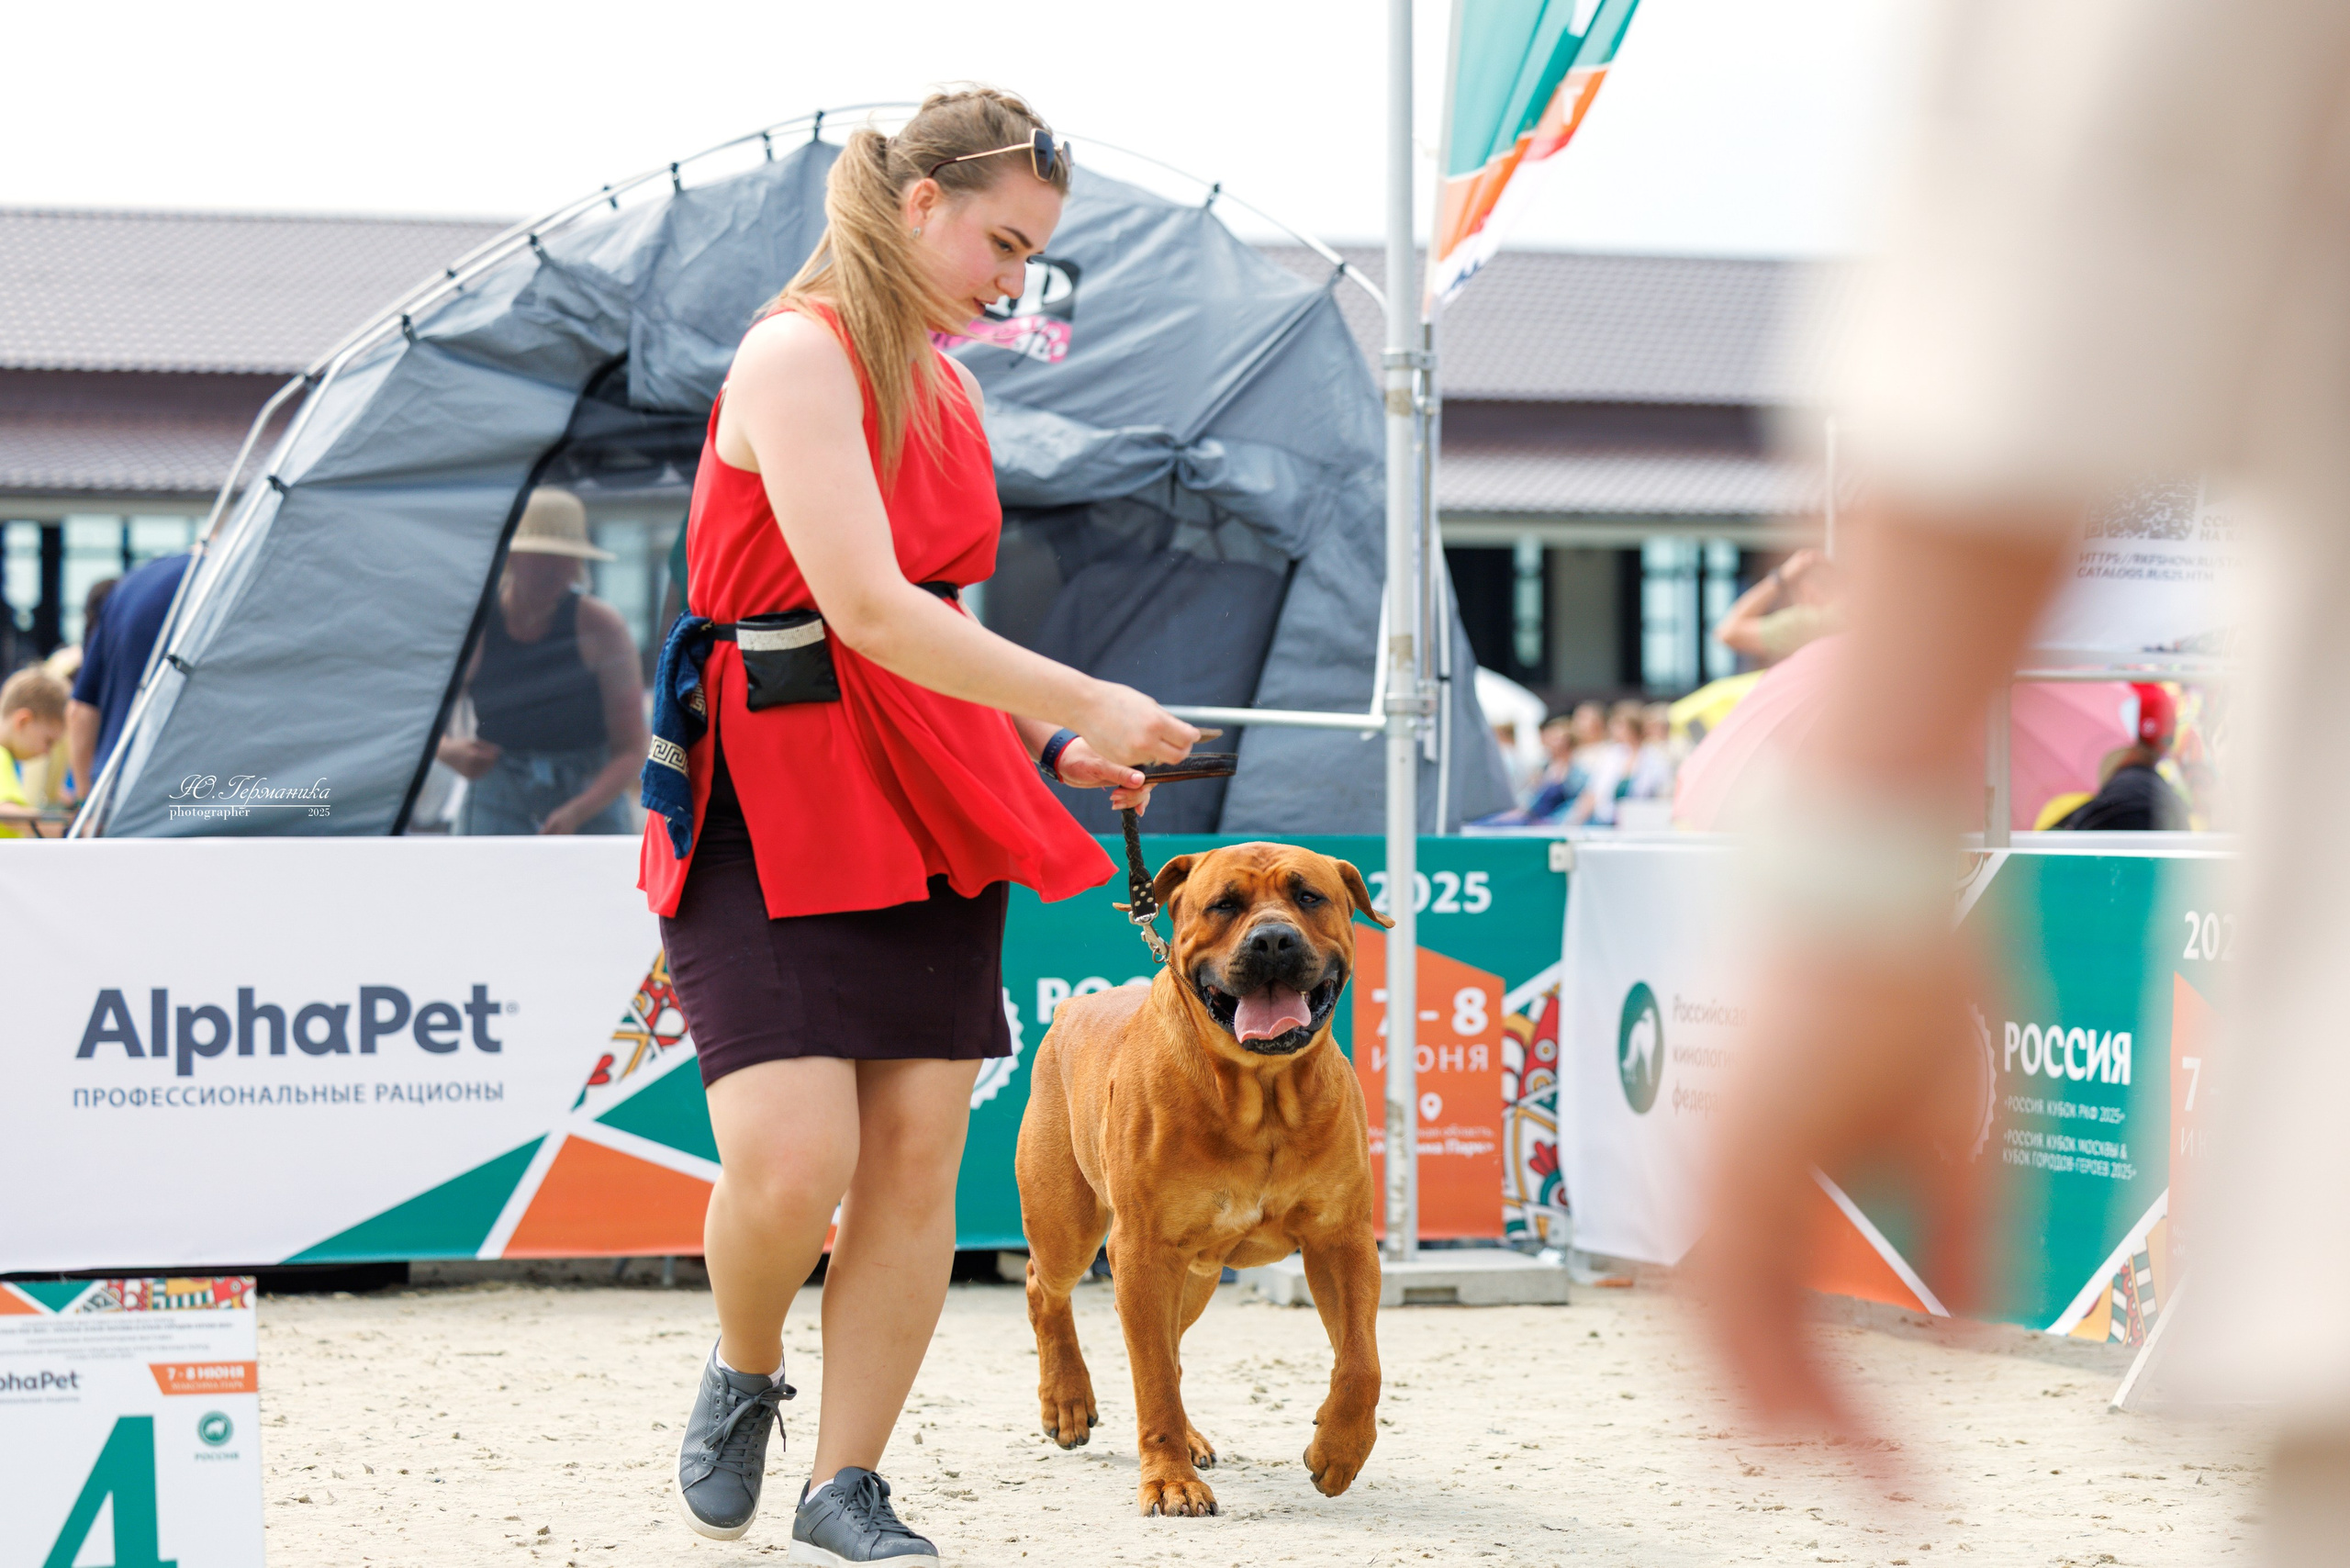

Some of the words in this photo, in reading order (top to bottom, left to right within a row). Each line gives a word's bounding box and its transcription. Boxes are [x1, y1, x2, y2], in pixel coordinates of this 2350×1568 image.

[2182, 910, 2235, 962] 202
[75, 982, 503, 1077] AlphaPet
[1451, 987, 1490, 1036] 8
[1673, 992, 1747, 1026] Российская
[2004, 1021, 2132, 1085] РОССИЯ
[73, 1083, 366, 1108] ПРОФЕССИОНАЛЬНЫЕ
[375, 1081, 504, 1107] РАЦИОНЫ
[2046, 1100, 2076, 1118] КУБОК
[2045, 1134, 2076, 1152] КУБОК
[167, 1367, 175, 1381] 7
[186, 1367, 196, 1380] 8
[42, 1415, 178, 1568] 4
